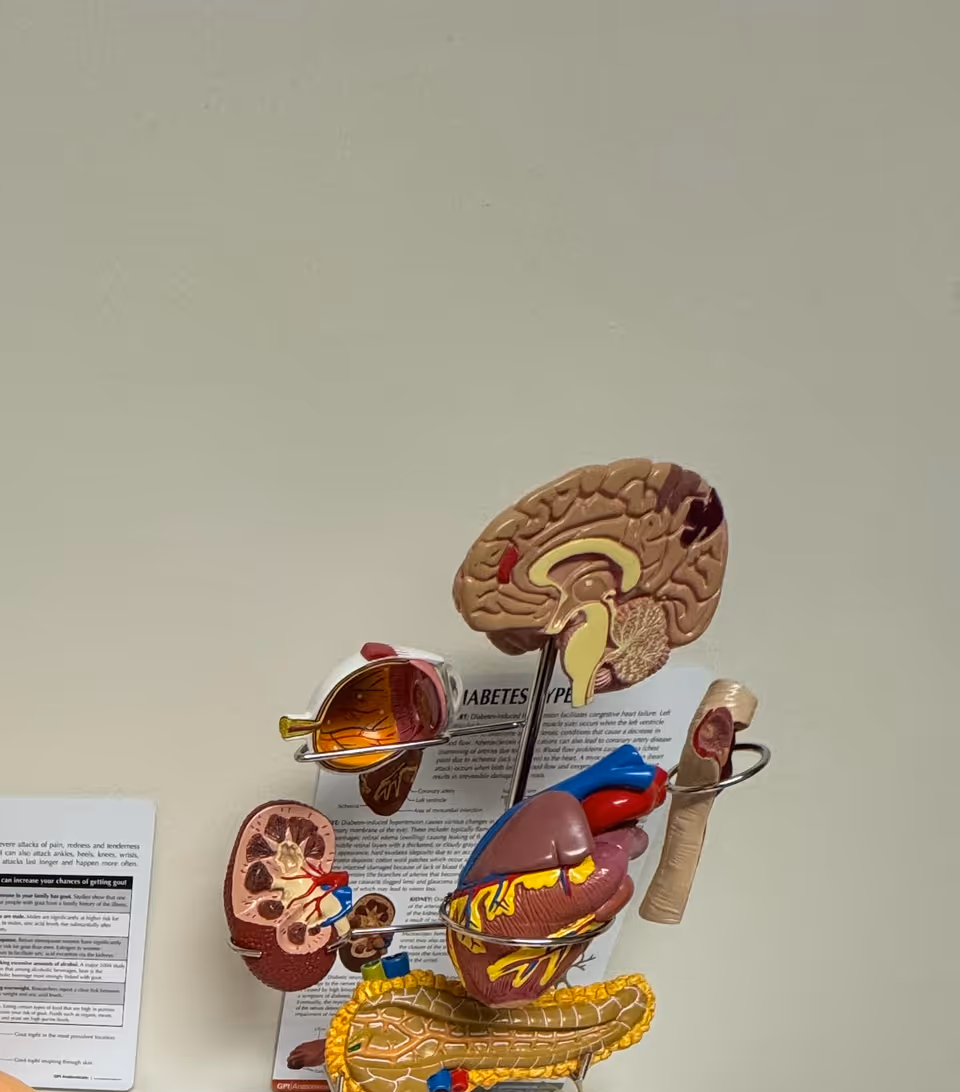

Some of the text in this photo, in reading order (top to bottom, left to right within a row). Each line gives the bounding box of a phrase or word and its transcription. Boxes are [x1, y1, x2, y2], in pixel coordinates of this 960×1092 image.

[462, 687, 572, 706] IABETES YPE
[113, 879, 127, 887] gout
